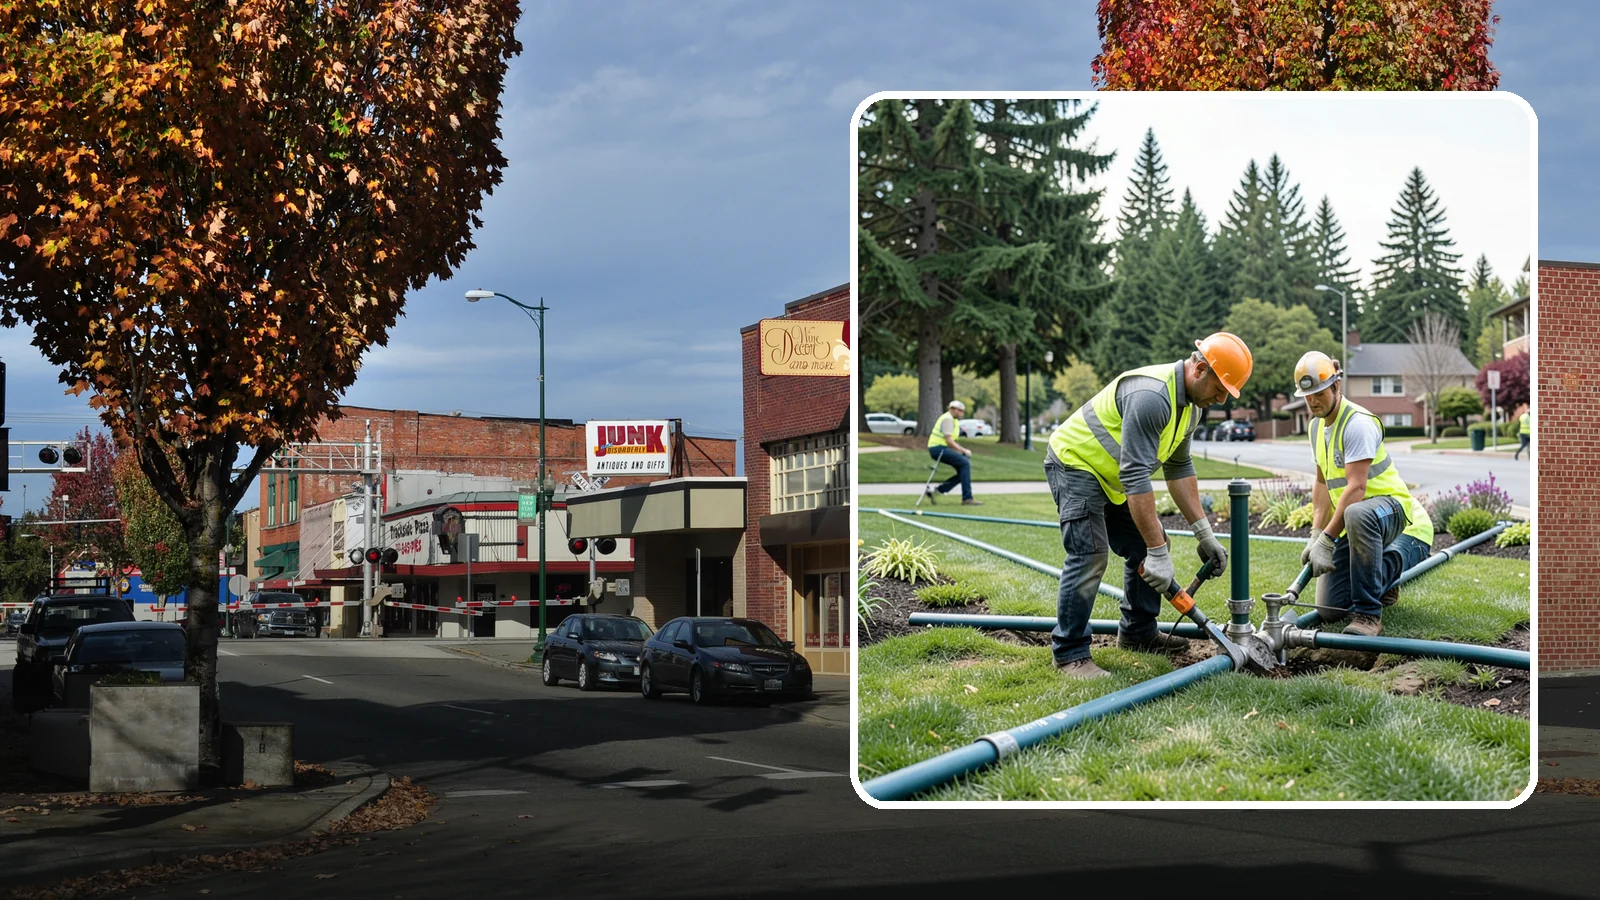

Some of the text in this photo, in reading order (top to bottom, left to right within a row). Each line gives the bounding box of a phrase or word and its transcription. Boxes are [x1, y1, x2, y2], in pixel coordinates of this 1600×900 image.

[595, 425, 665, 457] JUNK
[607, 446, 646, 454] DISORDERLY
[596, 460, 665, 470] ANTIQUES AND GIFTS
[573, 474, 588, 490] RAIL
[390, 519, 429, 540] Trackside Pizza
